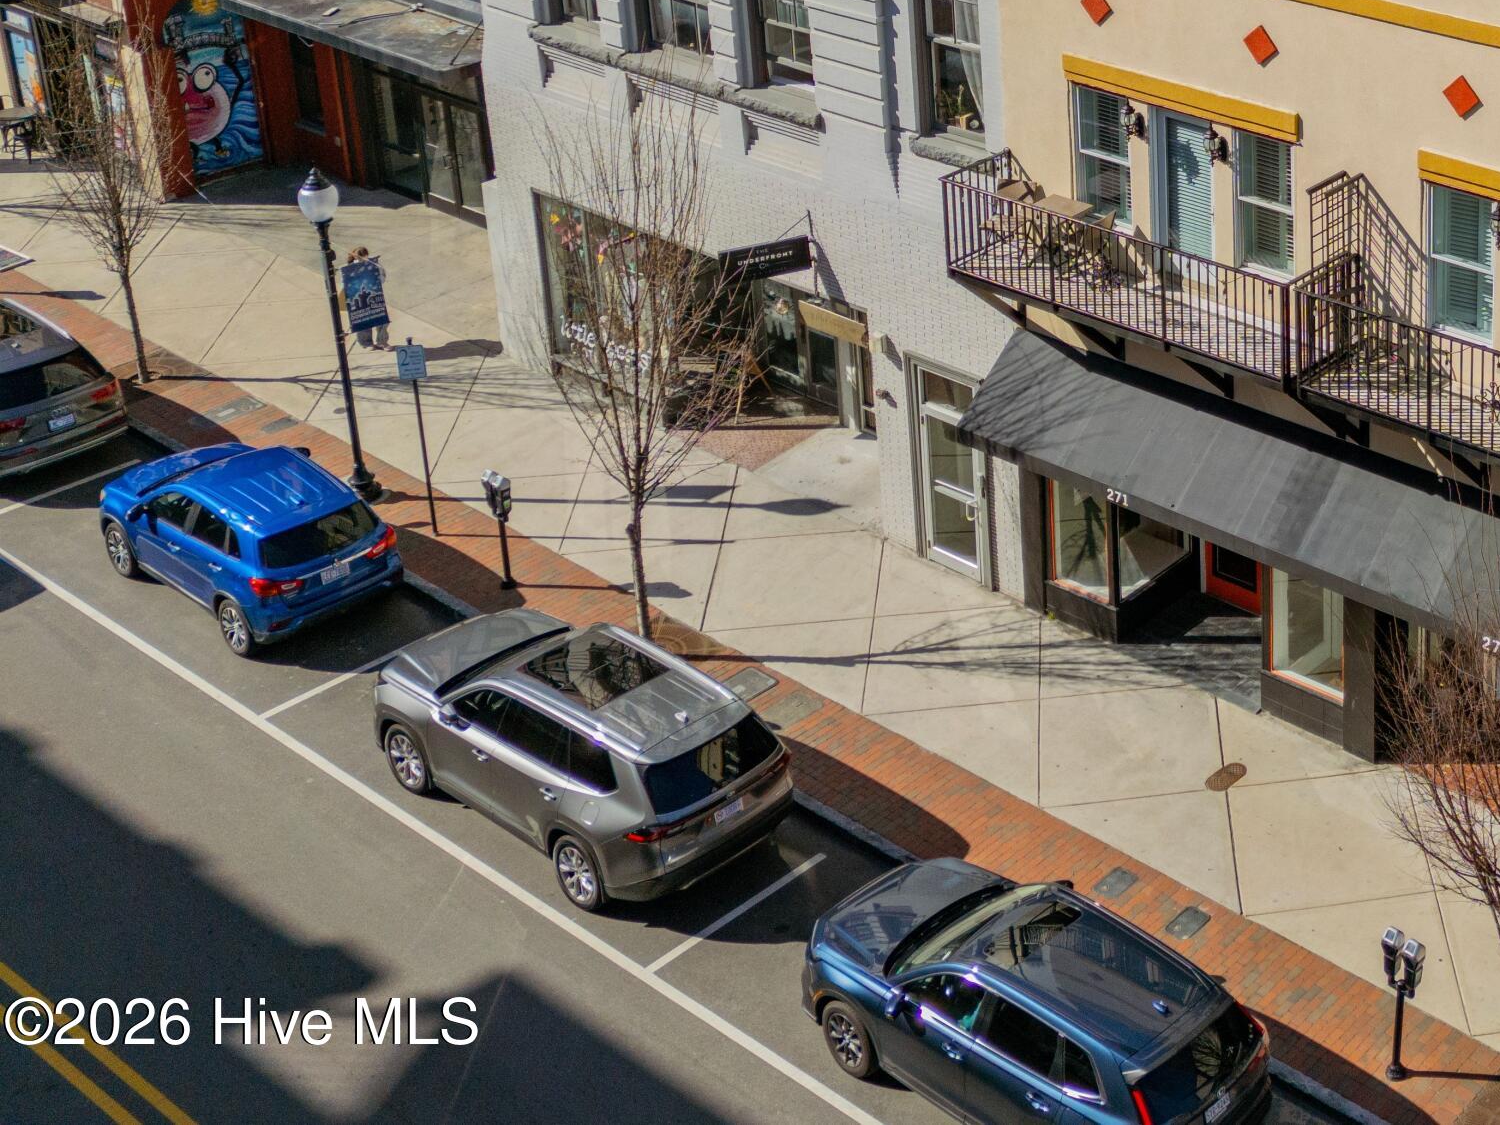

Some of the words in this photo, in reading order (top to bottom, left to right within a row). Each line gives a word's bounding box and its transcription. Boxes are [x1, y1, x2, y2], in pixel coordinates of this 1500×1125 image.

[737, 250, 793, 266] UNDERFRONT
[400, 349, 410, 367] 2
[1106, 488, 1129, 507] 271
